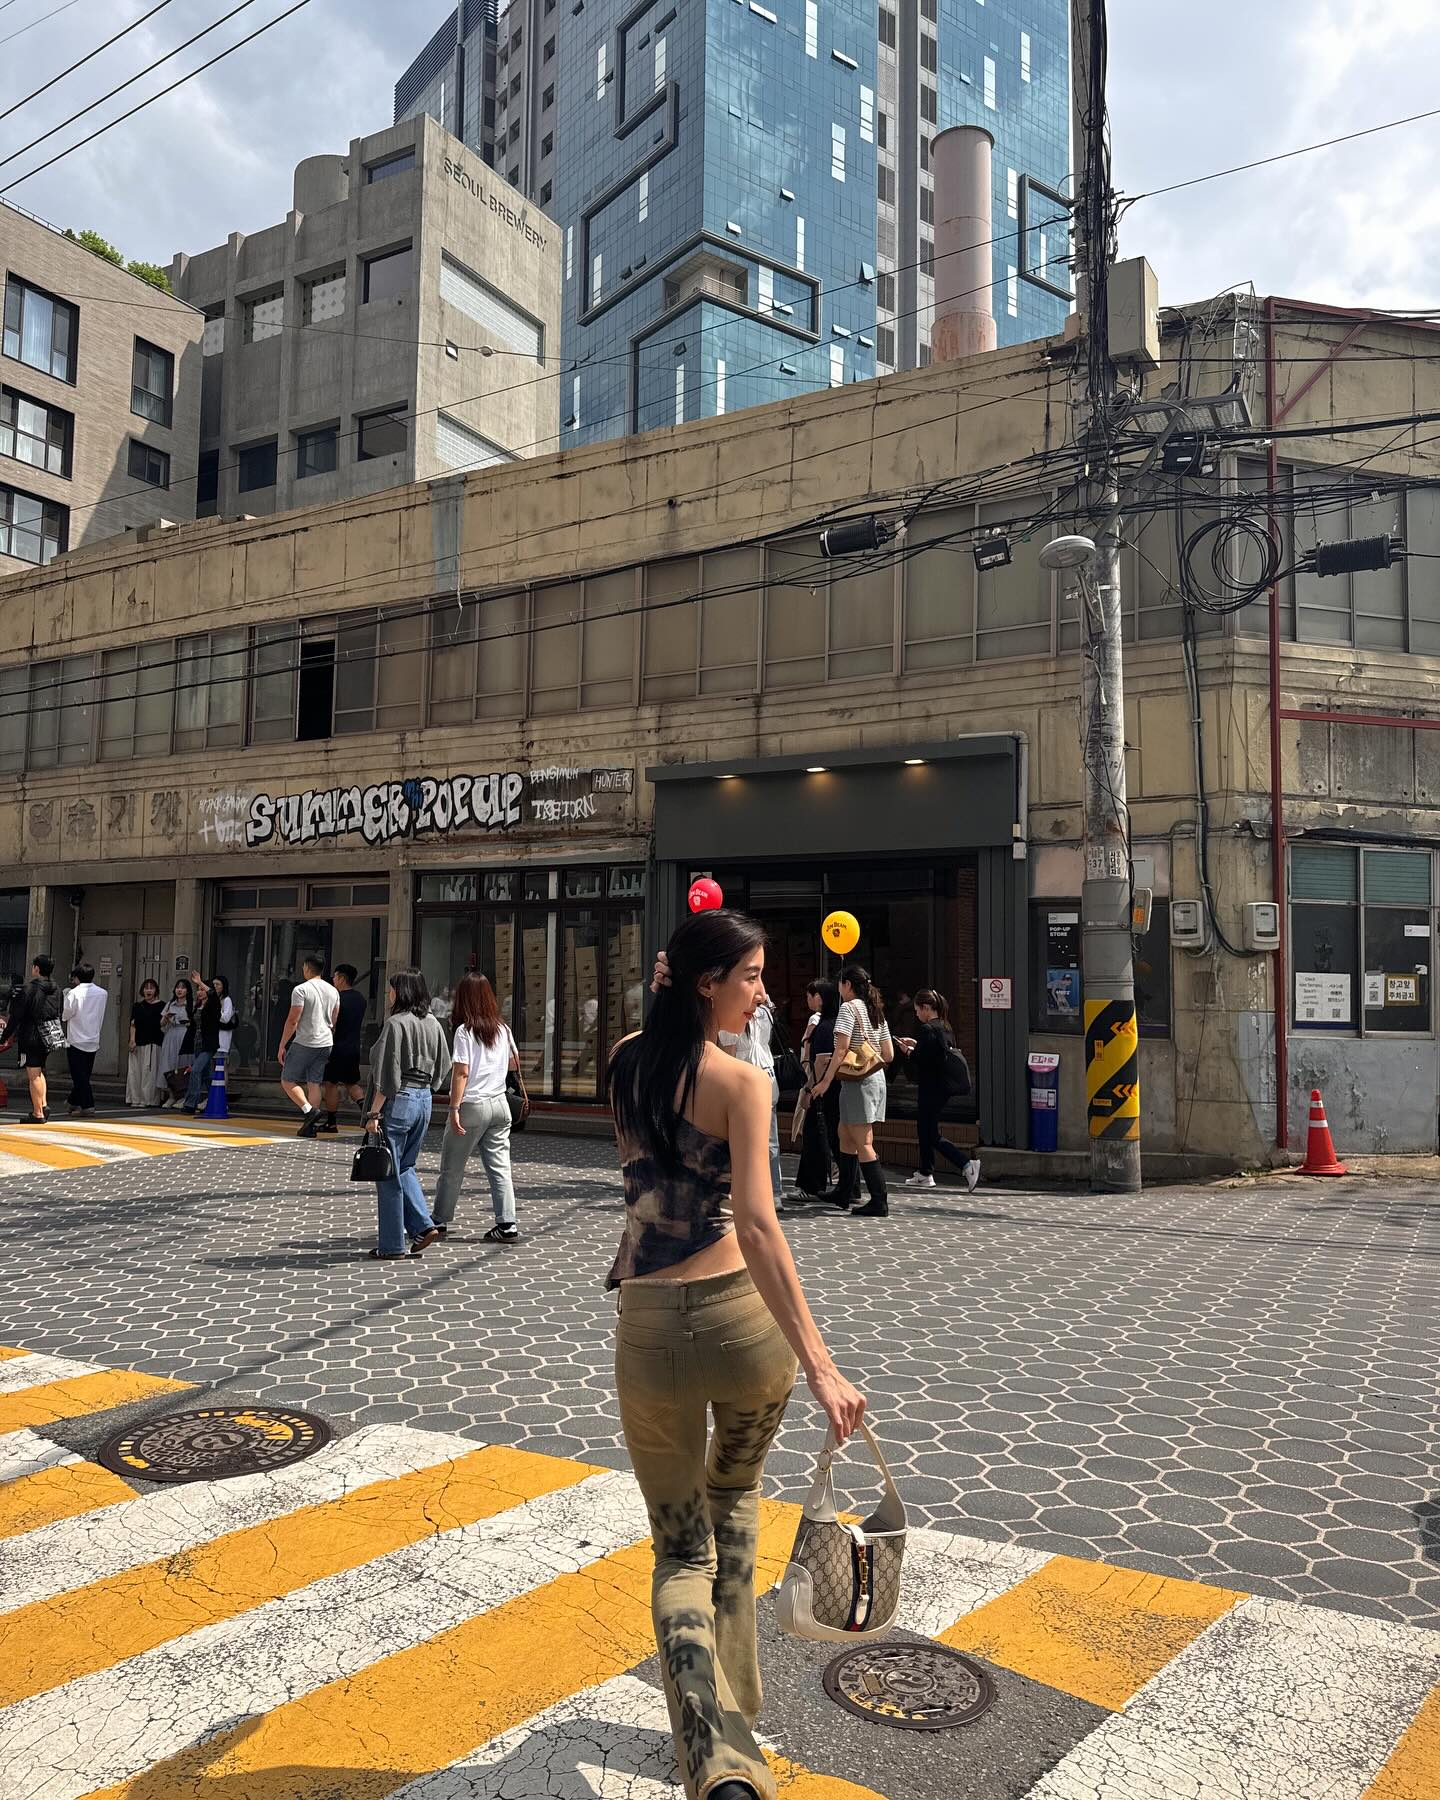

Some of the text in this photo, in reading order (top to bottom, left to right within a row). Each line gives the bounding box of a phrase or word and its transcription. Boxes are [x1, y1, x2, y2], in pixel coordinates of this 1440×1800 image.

[443, 157, 547, 252] SEOUL BREWERY
[594, 770, 632, 791] HUNTER
[245, 780, 410, 847] SUMMER
[1389, 991, 1414, 999] 주차금지
